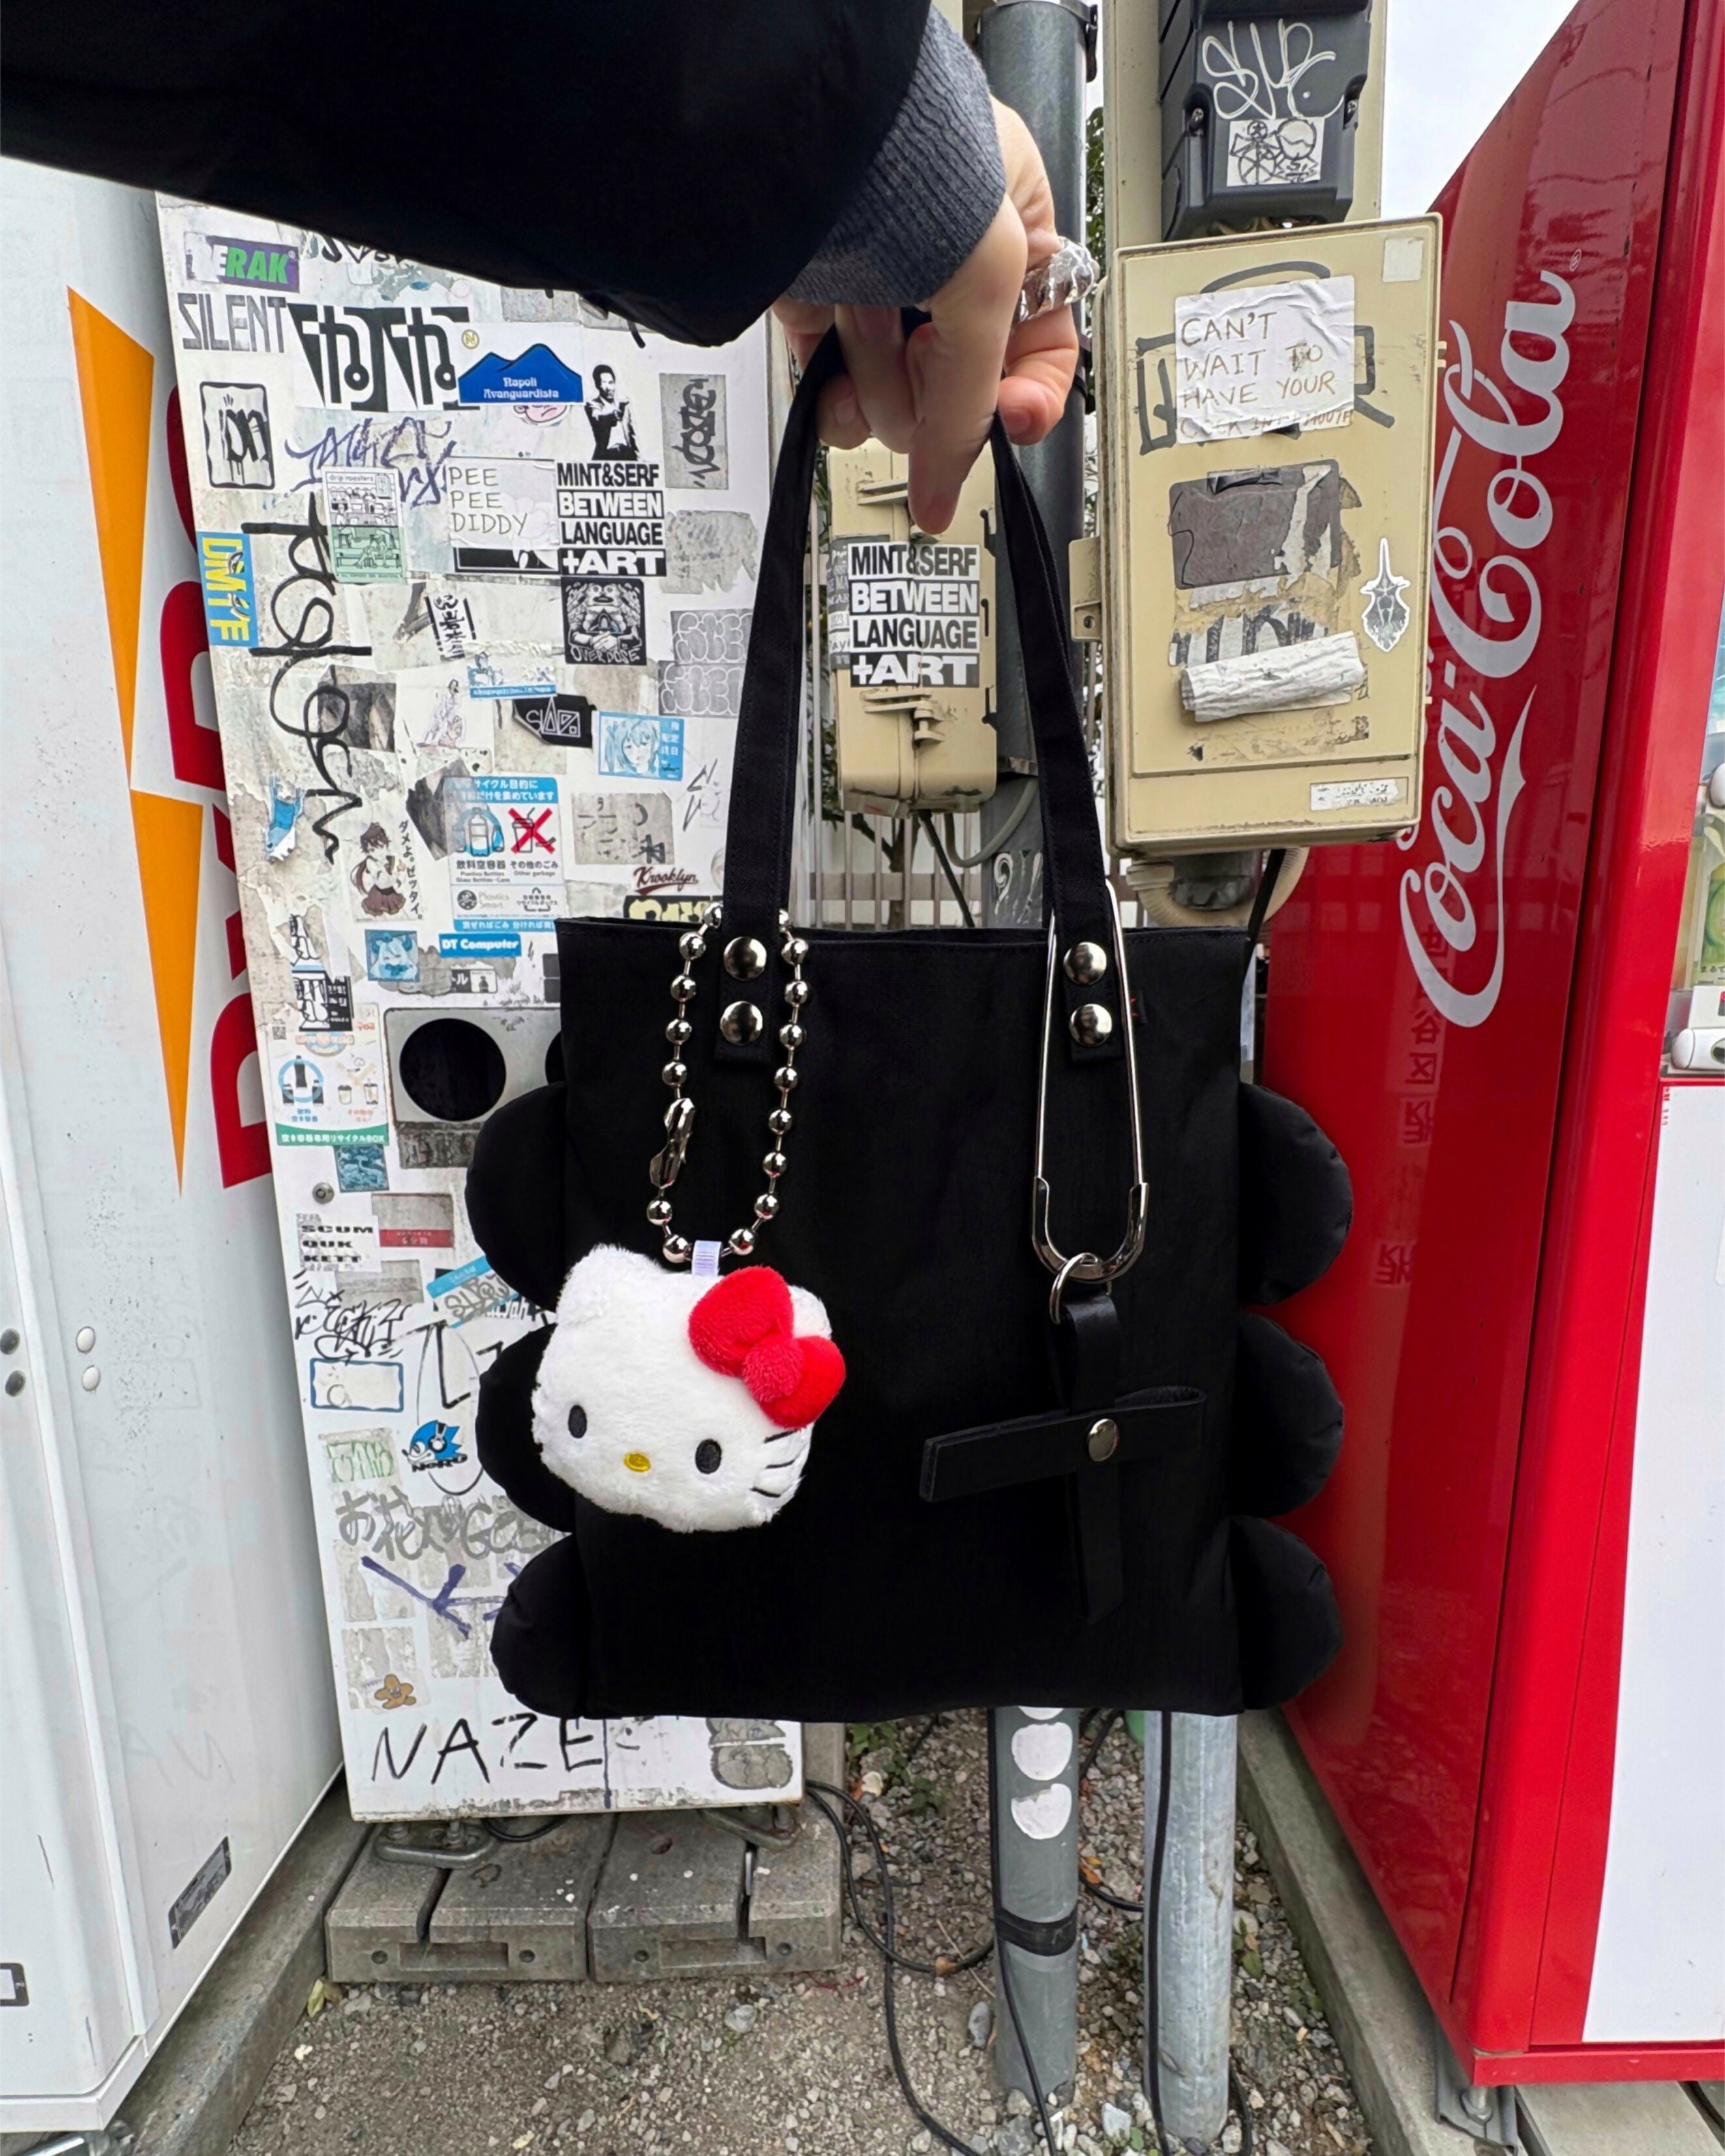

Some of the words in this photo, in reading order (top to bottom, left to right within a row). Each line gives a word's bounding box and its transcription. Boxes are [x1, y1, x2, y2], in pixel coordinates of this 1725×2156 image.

[189, 244, 289, 284] ERAK
[177, 293, 287, 353] SILENT
[1180, 312, 1278, 347] CAN'T
[1184, 350, 1267, 381] WAIT
[1183, 383, 1259, 409] HAVE
[1276, 370, 1336, 400] YOUR
[449, 468, 498, 487] PEE
[557, 462, 659, 487] MINT&SERF
[451, 492, 503, 509] PEE
[560, 492, 663, 518] BETWEEN
[451, 513, 528, 536] DIDDY
[562, 522, 663, 545] LANGUAGE
[563, 550, 664, 575] +ART
[852, 545, 976, 576] MINT&SERF
[852, 582, 978, 614] BETWEEN
[852, 618, 977, 649] LANGUAGE
[1399, 269, 1576, 1028] Coca-Cola
[852, 654, 978, 685] +ART
[510, 860, 559, 869] その他のごみ
[633, 866, 698, 893] Krooklyn
[442, 938, 458, 950] DT
[460, 938, 519, 951] Computer
[301, 1225, 374, 1234] SCUM
[372, 1714, 603, 1784] NAZE
